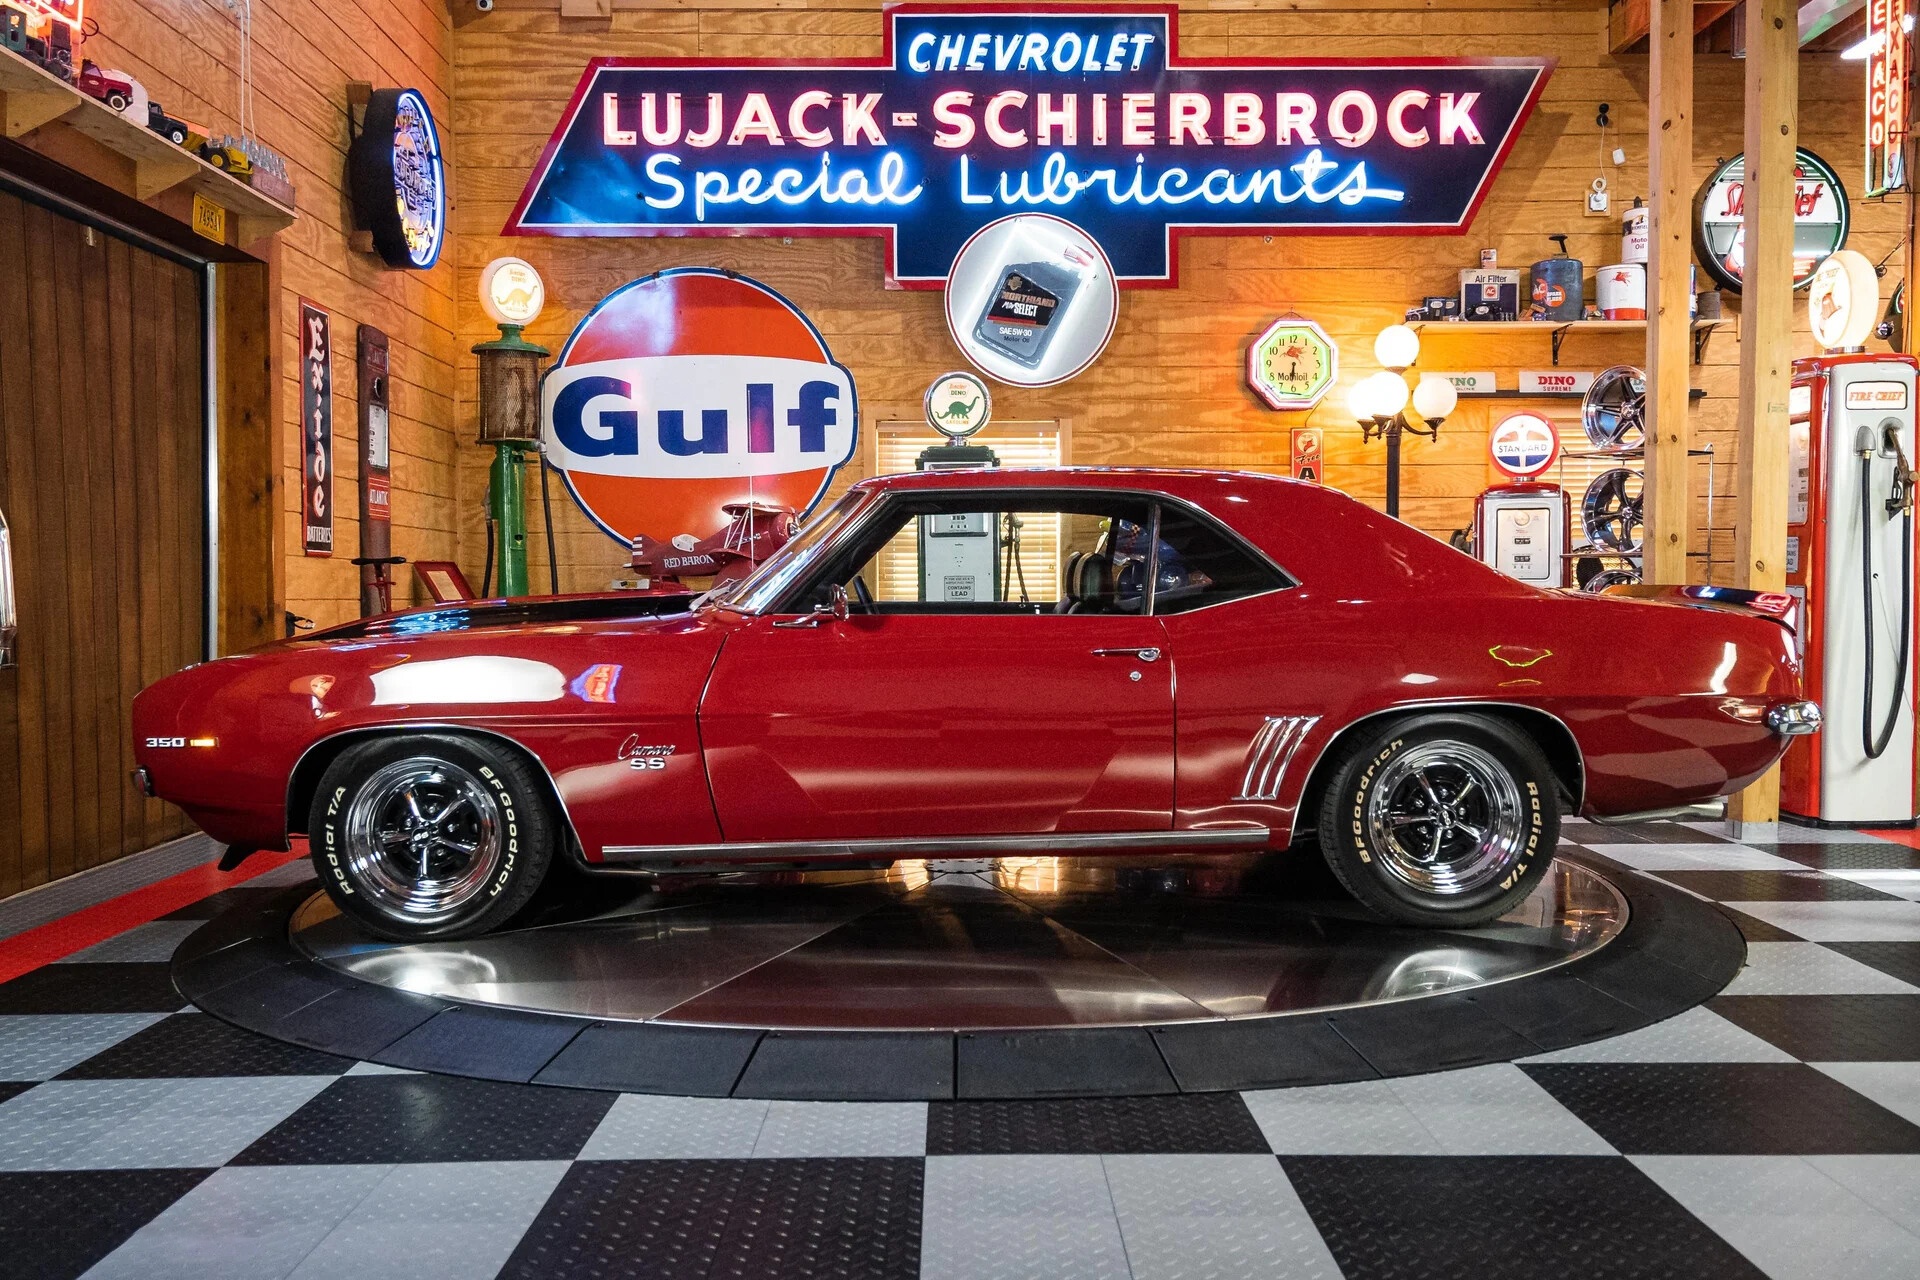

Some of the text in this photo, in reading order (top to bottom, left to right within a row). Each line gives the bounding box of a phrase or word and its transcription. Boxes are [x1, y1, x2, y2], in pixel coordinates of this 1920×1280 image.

[908, 33, 1155, 72] CHEVROLET
[603, 90, 1486, 147] LUJACK-SCHIERBROCK
[642, 149, 1405, 222] Special Lubricants
[1475, 275, 1507, 283] Air Filter
[1533, 284, 1547, 295] AC
[999, 326, 1033, 337] SAE 5W-30
[1003, 335, 1020, 343] Motor
[1289, 335, 1298, 344] 12
[1269, 347, 1279, 355] 10
[1312, 346, 1318, 355] 2
[1265, 360, 1272, 368] 9
[1315, 359, 1321, 368] 3
[1268, 372, 1275, 381] 8
[1312, 373, 1318, 381] 4
[1538, 375, 1576, 386] DINO
[1279, 382, 1284, 391] 7
[1290, 384, 1297, 393] 6
[1304, 382, 1310, 390] 5
[552, 376, 840, 457] Gulf
[1294, 453, 1321, 465] Free
[369, 487, 389, 506] ATLANTIC
[306, 525, 332, 544] BATTERIES
[663, 554, 715, 569] RED BARON
[145, 737, 186, 748] 350
[618, 733, 676, 760] Camaro
[630, 757, 666, 770] SS
[1352, 739, 1404, 864] BFGoodrich
[478, 765, 519, 897] BFGoodrich
[1499, 781, 1543, 891] Radial T/A
[325, 785, 355, 896] Radial T/A
